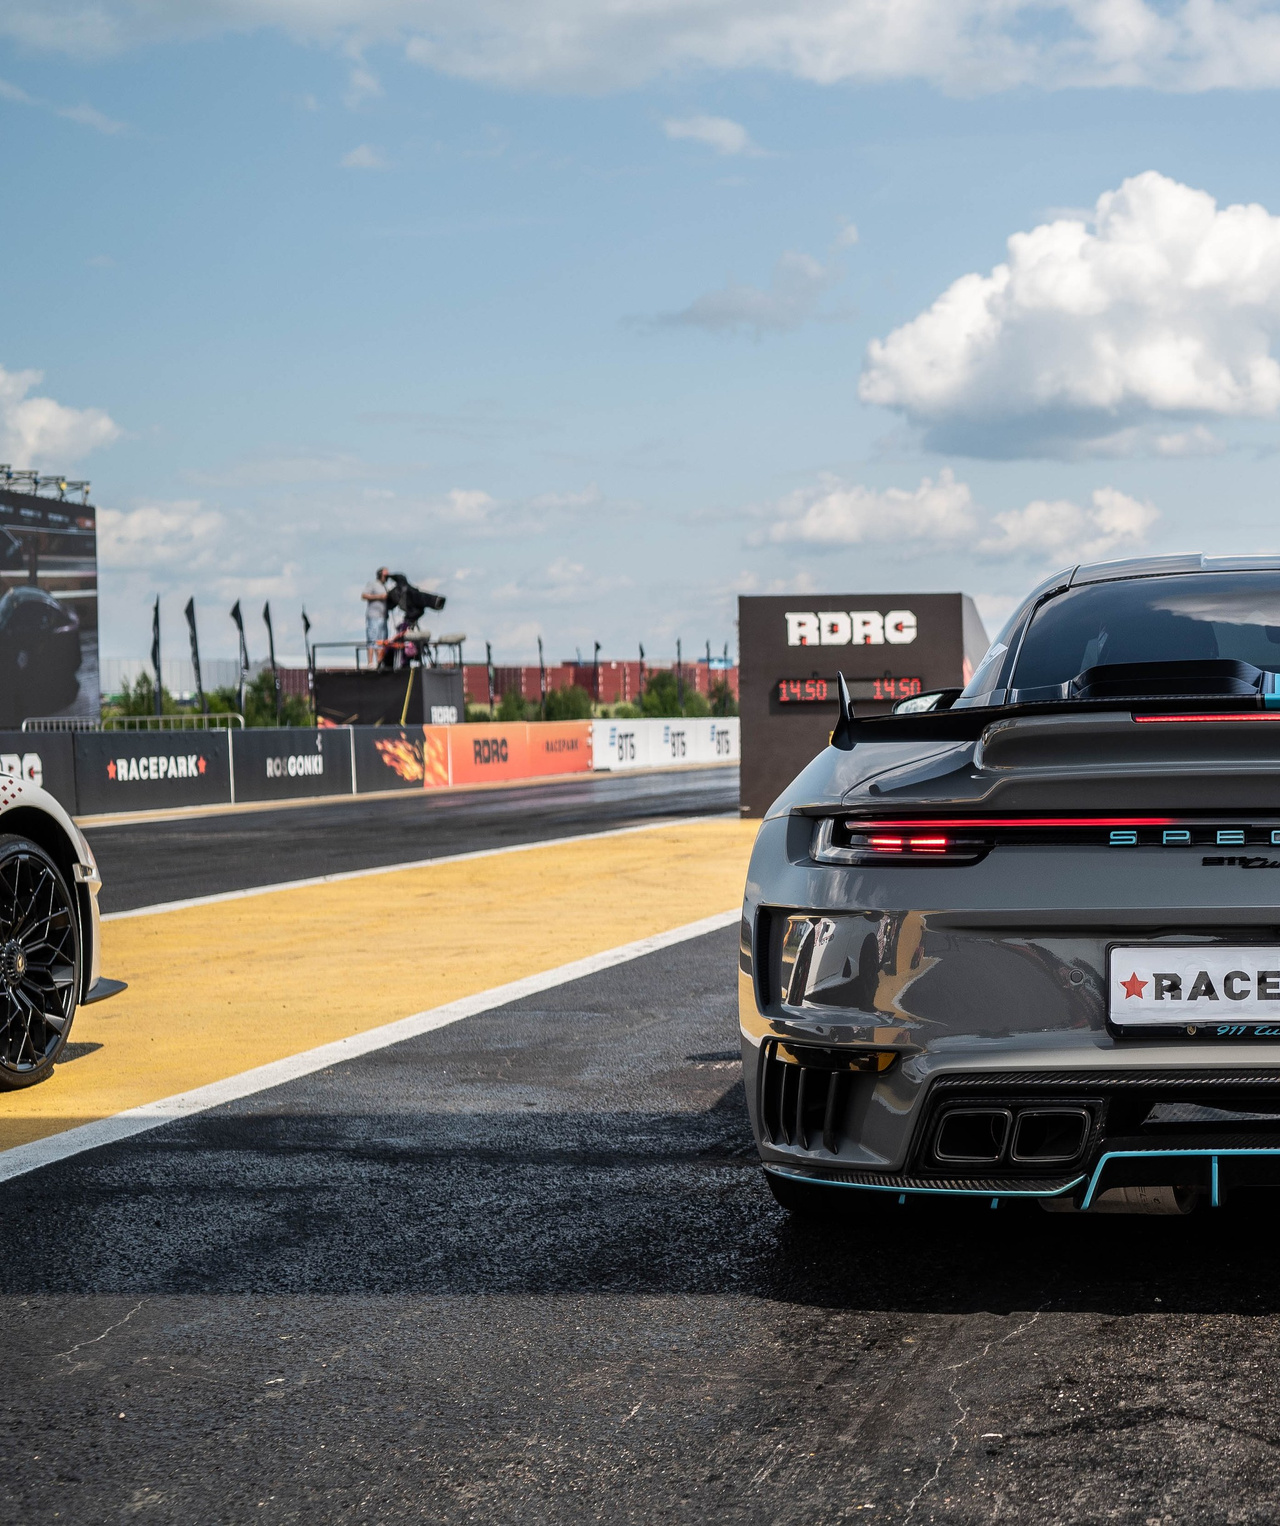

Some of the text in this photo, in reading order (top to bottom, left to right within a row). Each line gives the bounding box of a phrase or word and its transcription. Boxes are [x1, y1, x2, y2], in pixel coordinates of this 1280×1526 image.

[785, 610, 917, 646] RDRC
[779, 679, 828, 702] 14.50
[473, 737, 508, 764] RDRC
[116, 754, 198, 782] RACEPARK
[266, 754, 323, 779] ROSGONKI
[1216, 1024, 1247, 1036] 911
